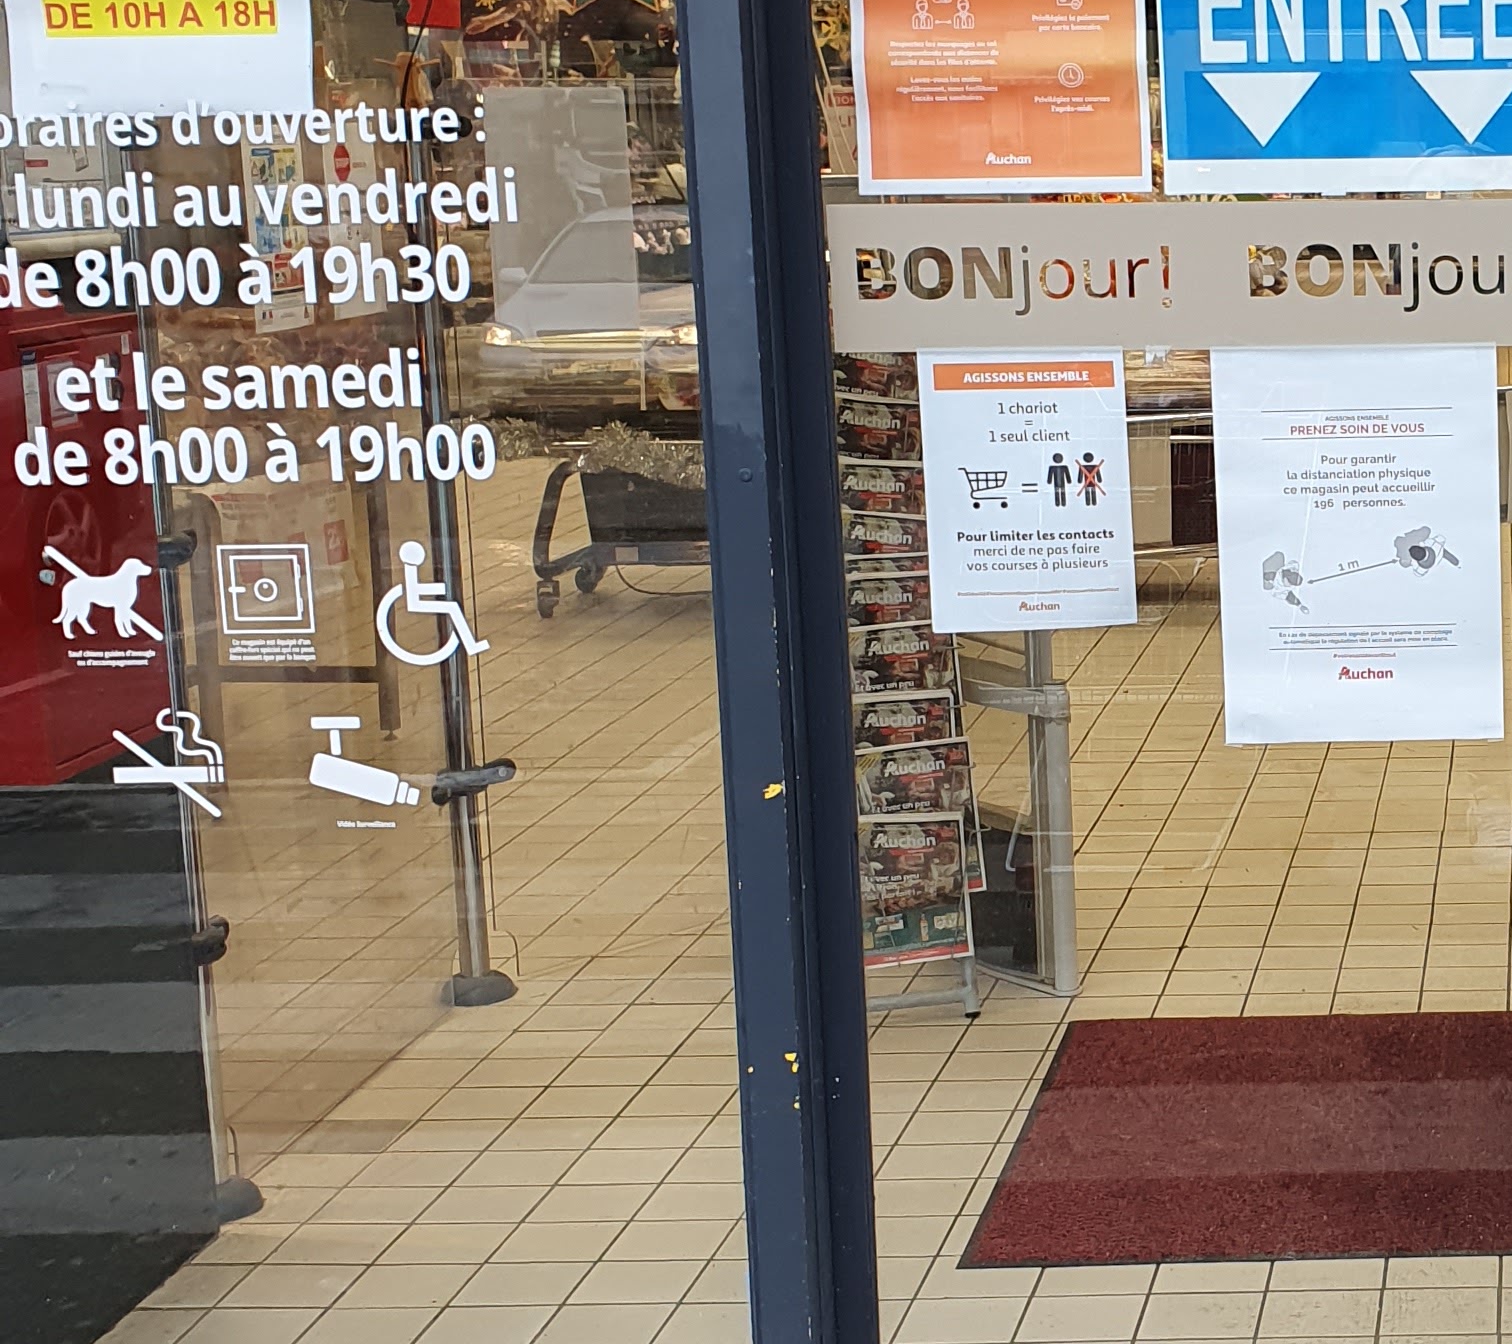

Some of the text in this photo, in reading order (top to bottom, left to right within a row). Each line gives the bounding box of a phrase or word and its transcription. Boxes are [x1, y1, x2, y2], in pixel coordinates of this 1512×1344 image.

[45, 2, 92, 30] DE
[105, 0, 167, 30] 10H
[172, 100, 459, 146] d'ouverture
[986, 152, 1032, 166] Auchan
[14, 167, 519, 229] lundi au vendredi
[0, 242, 471, 308] de 8h00 à 19h30
[857, 243, 1174, 315] BONjour!
[56, 348, 423, 412] et le samedi
[963, 370, 1090, 384] AGISSONS ENSEMBLE
[998, 401, 1058, 414] 1 chariot
[989, 429, 1070, 443] 1 seul client
[1290, 423, 1425, 436] PRENEZ SOIN DE VOUS
[14, 422, 498, 487] de 8h00 à 19h00
[1321, 453, 1396, 466] Pour garantir
[1287, 468, 1431, 481] la distanciation physique
[1283, 481, 1435, 496] ce magasin peut accueillir
[1313, 499, 1334, 510] 196
[957, 529, 1115, 542] Pour limiter les contacts
[973, 543, 1100, 558] merci de ne pas faire
[967, 557, 1108, 572] vos courses à plusieurs
[1019, 601, 1060, 612] Auchan
[868, 639, 930, 657] Auchan
[1338, 666, 1393, 681] Auchan
[873, 834, 937, 850] Auchan
